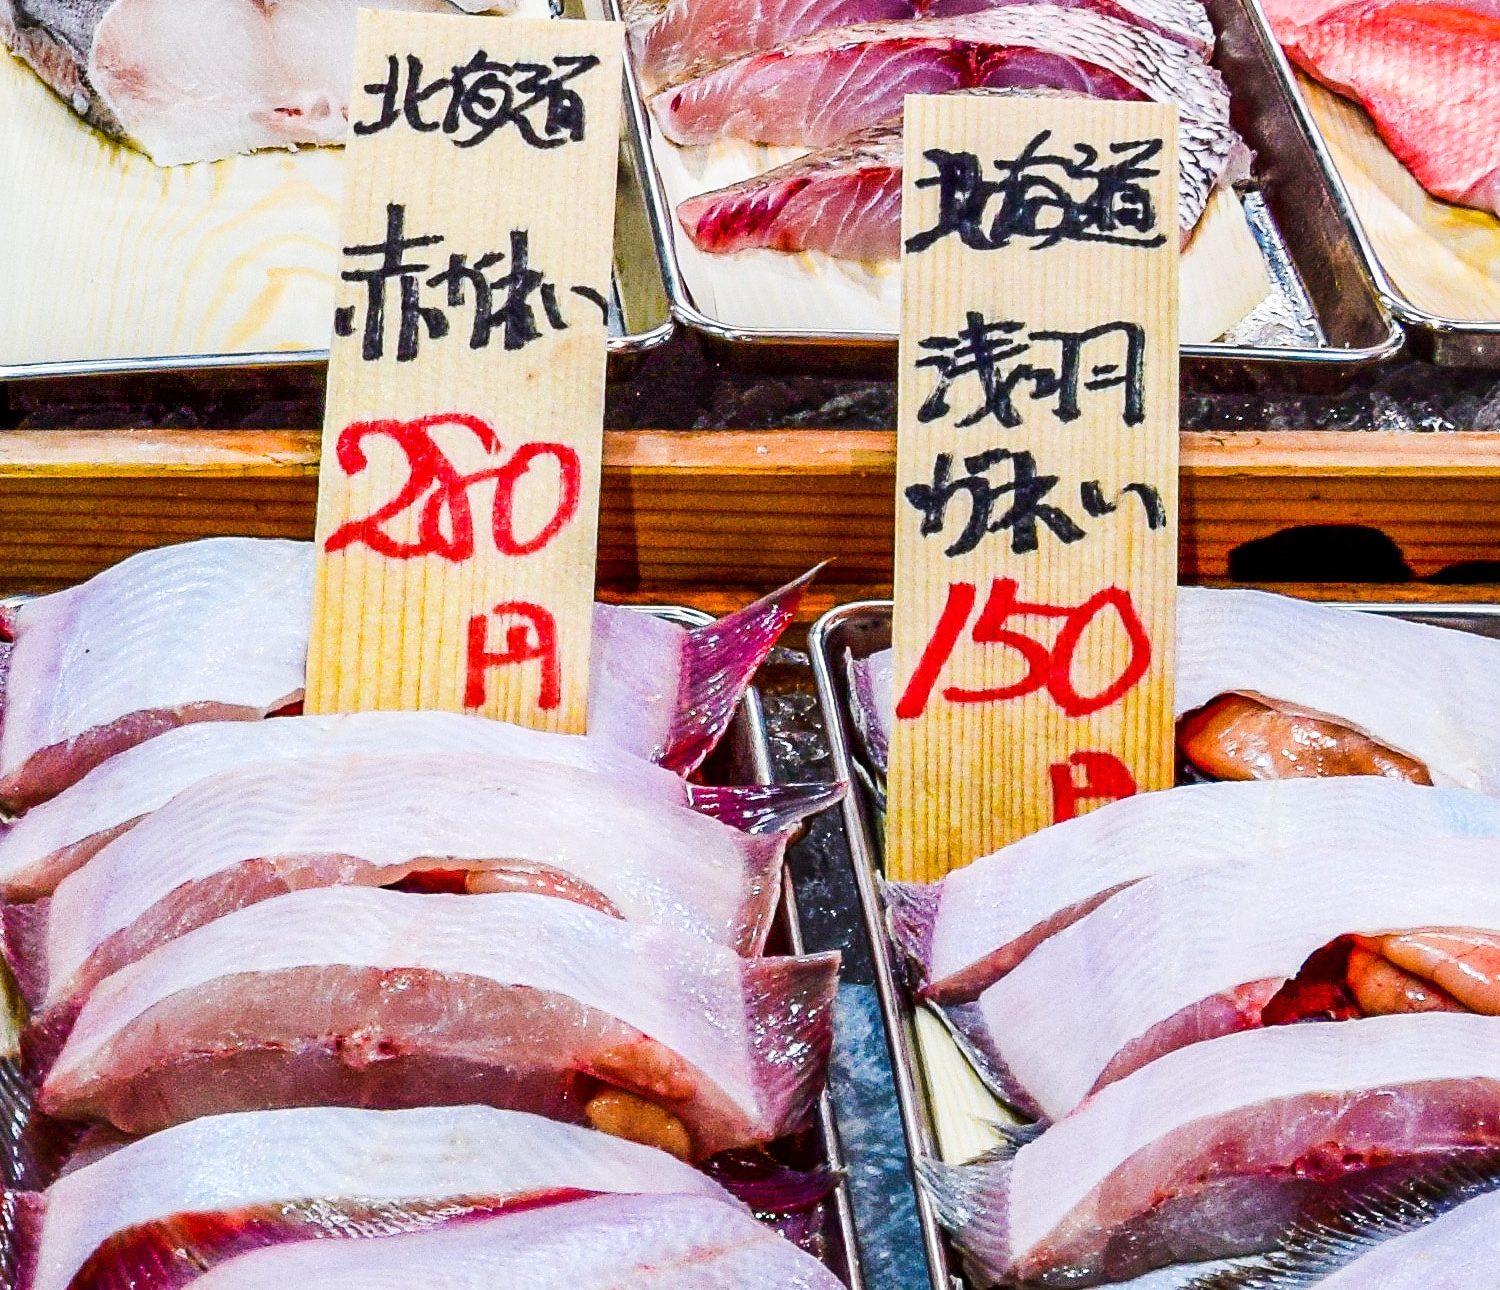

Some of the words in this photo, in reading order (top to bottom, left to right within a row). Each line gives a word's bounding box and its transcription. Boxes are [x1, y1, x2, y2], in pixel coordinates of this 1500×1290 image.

[352, 49, 601, 150] 北海道
[904, 129, 1166, 253] 北海道
[915, 311, 1147, 429] 浅羽
[463, 601, 561, 711] 円
[894, 577, 1152, 721] 150
